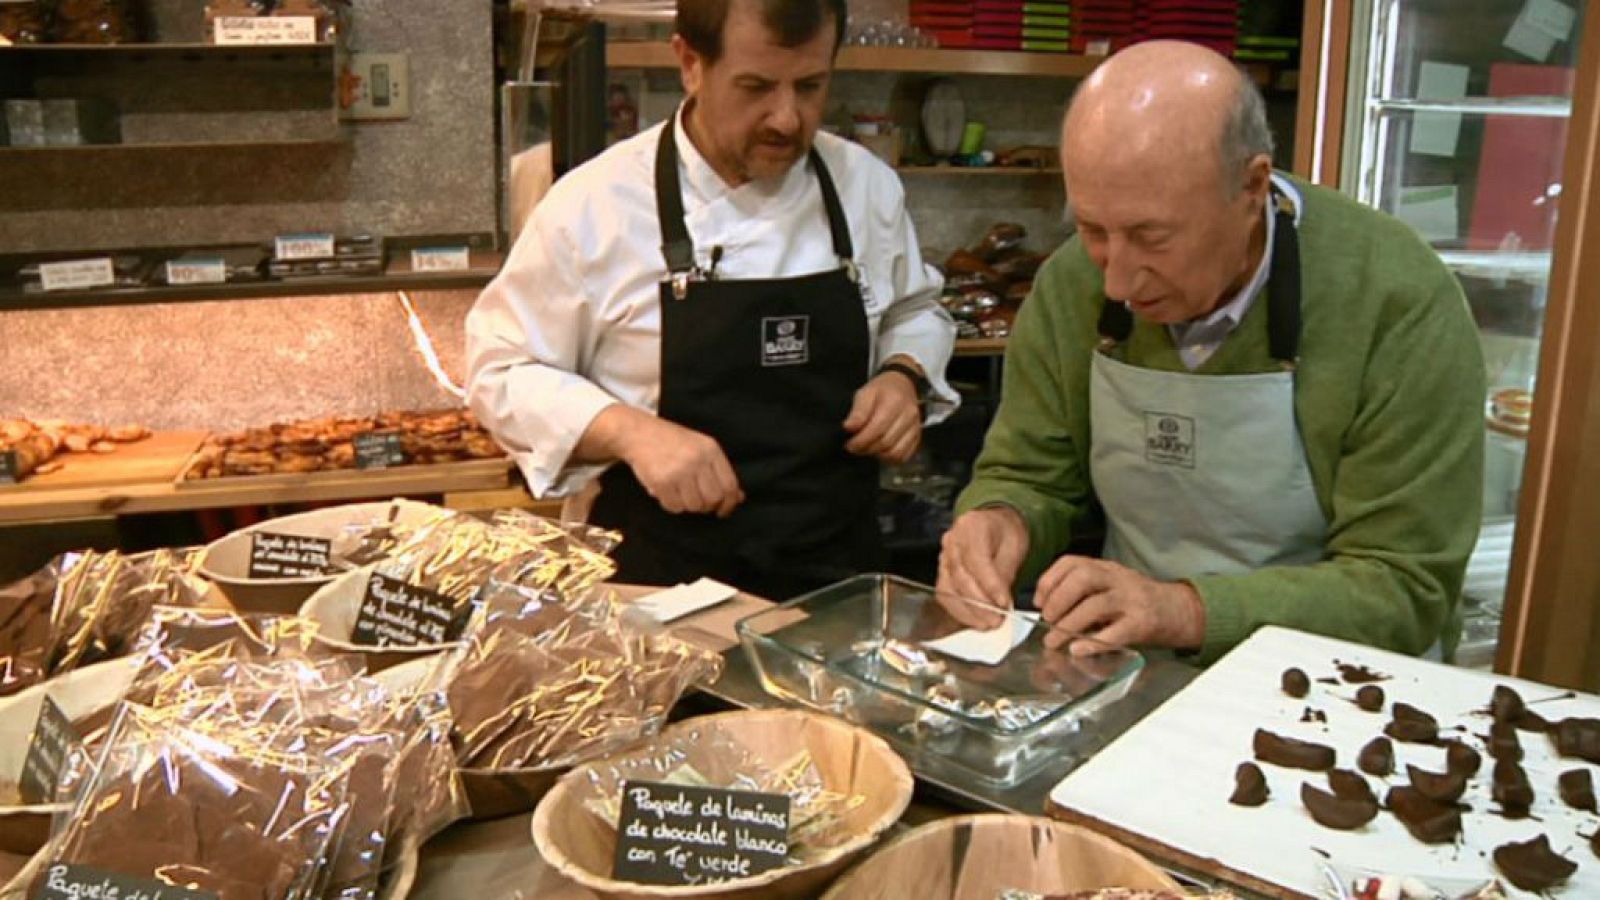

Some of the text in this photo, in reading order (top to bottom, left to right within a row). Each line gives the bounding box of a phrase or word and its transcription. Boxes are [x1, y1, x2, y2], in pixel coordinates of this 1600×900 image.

[629, 787, 787, 829] Paquete de laminas
[626, 819, 787, 855] de chocolate blanco
[627, 847, 656, 864] con
[699, 853, 751, 875] verde
[47, 864, 120, 900] Paquete
